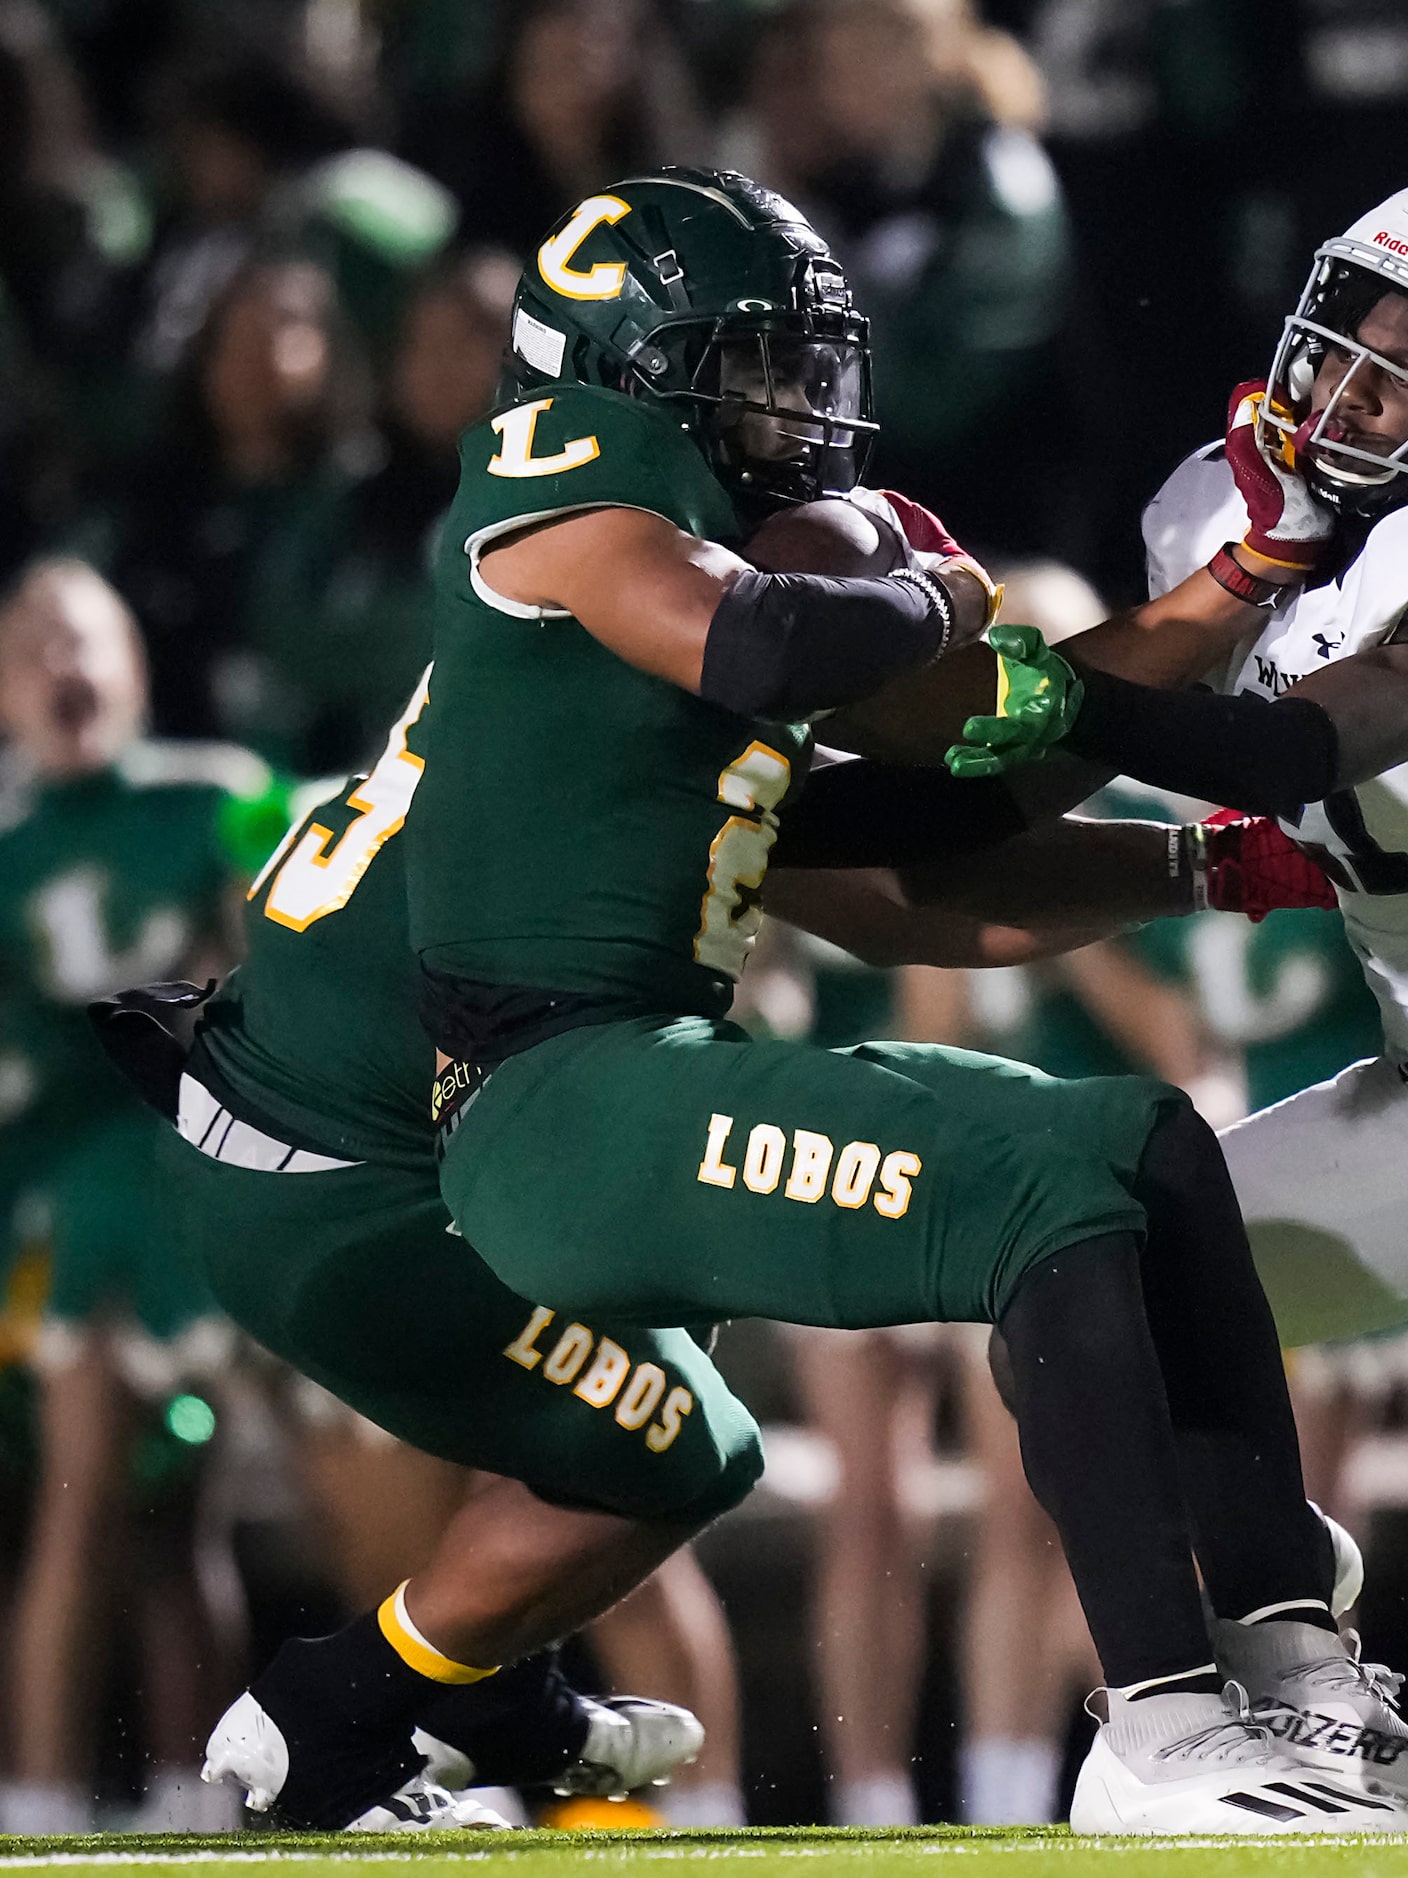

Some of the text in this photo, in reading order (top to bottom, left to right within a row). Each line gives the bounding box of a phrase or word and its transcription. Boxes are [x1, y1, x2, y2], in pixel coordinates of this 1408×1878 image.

[487, 398, 600, 478] L
[698, 1113, 922, 1219] LOBOS
[503, 1305, 693, 1453] LOBOS
